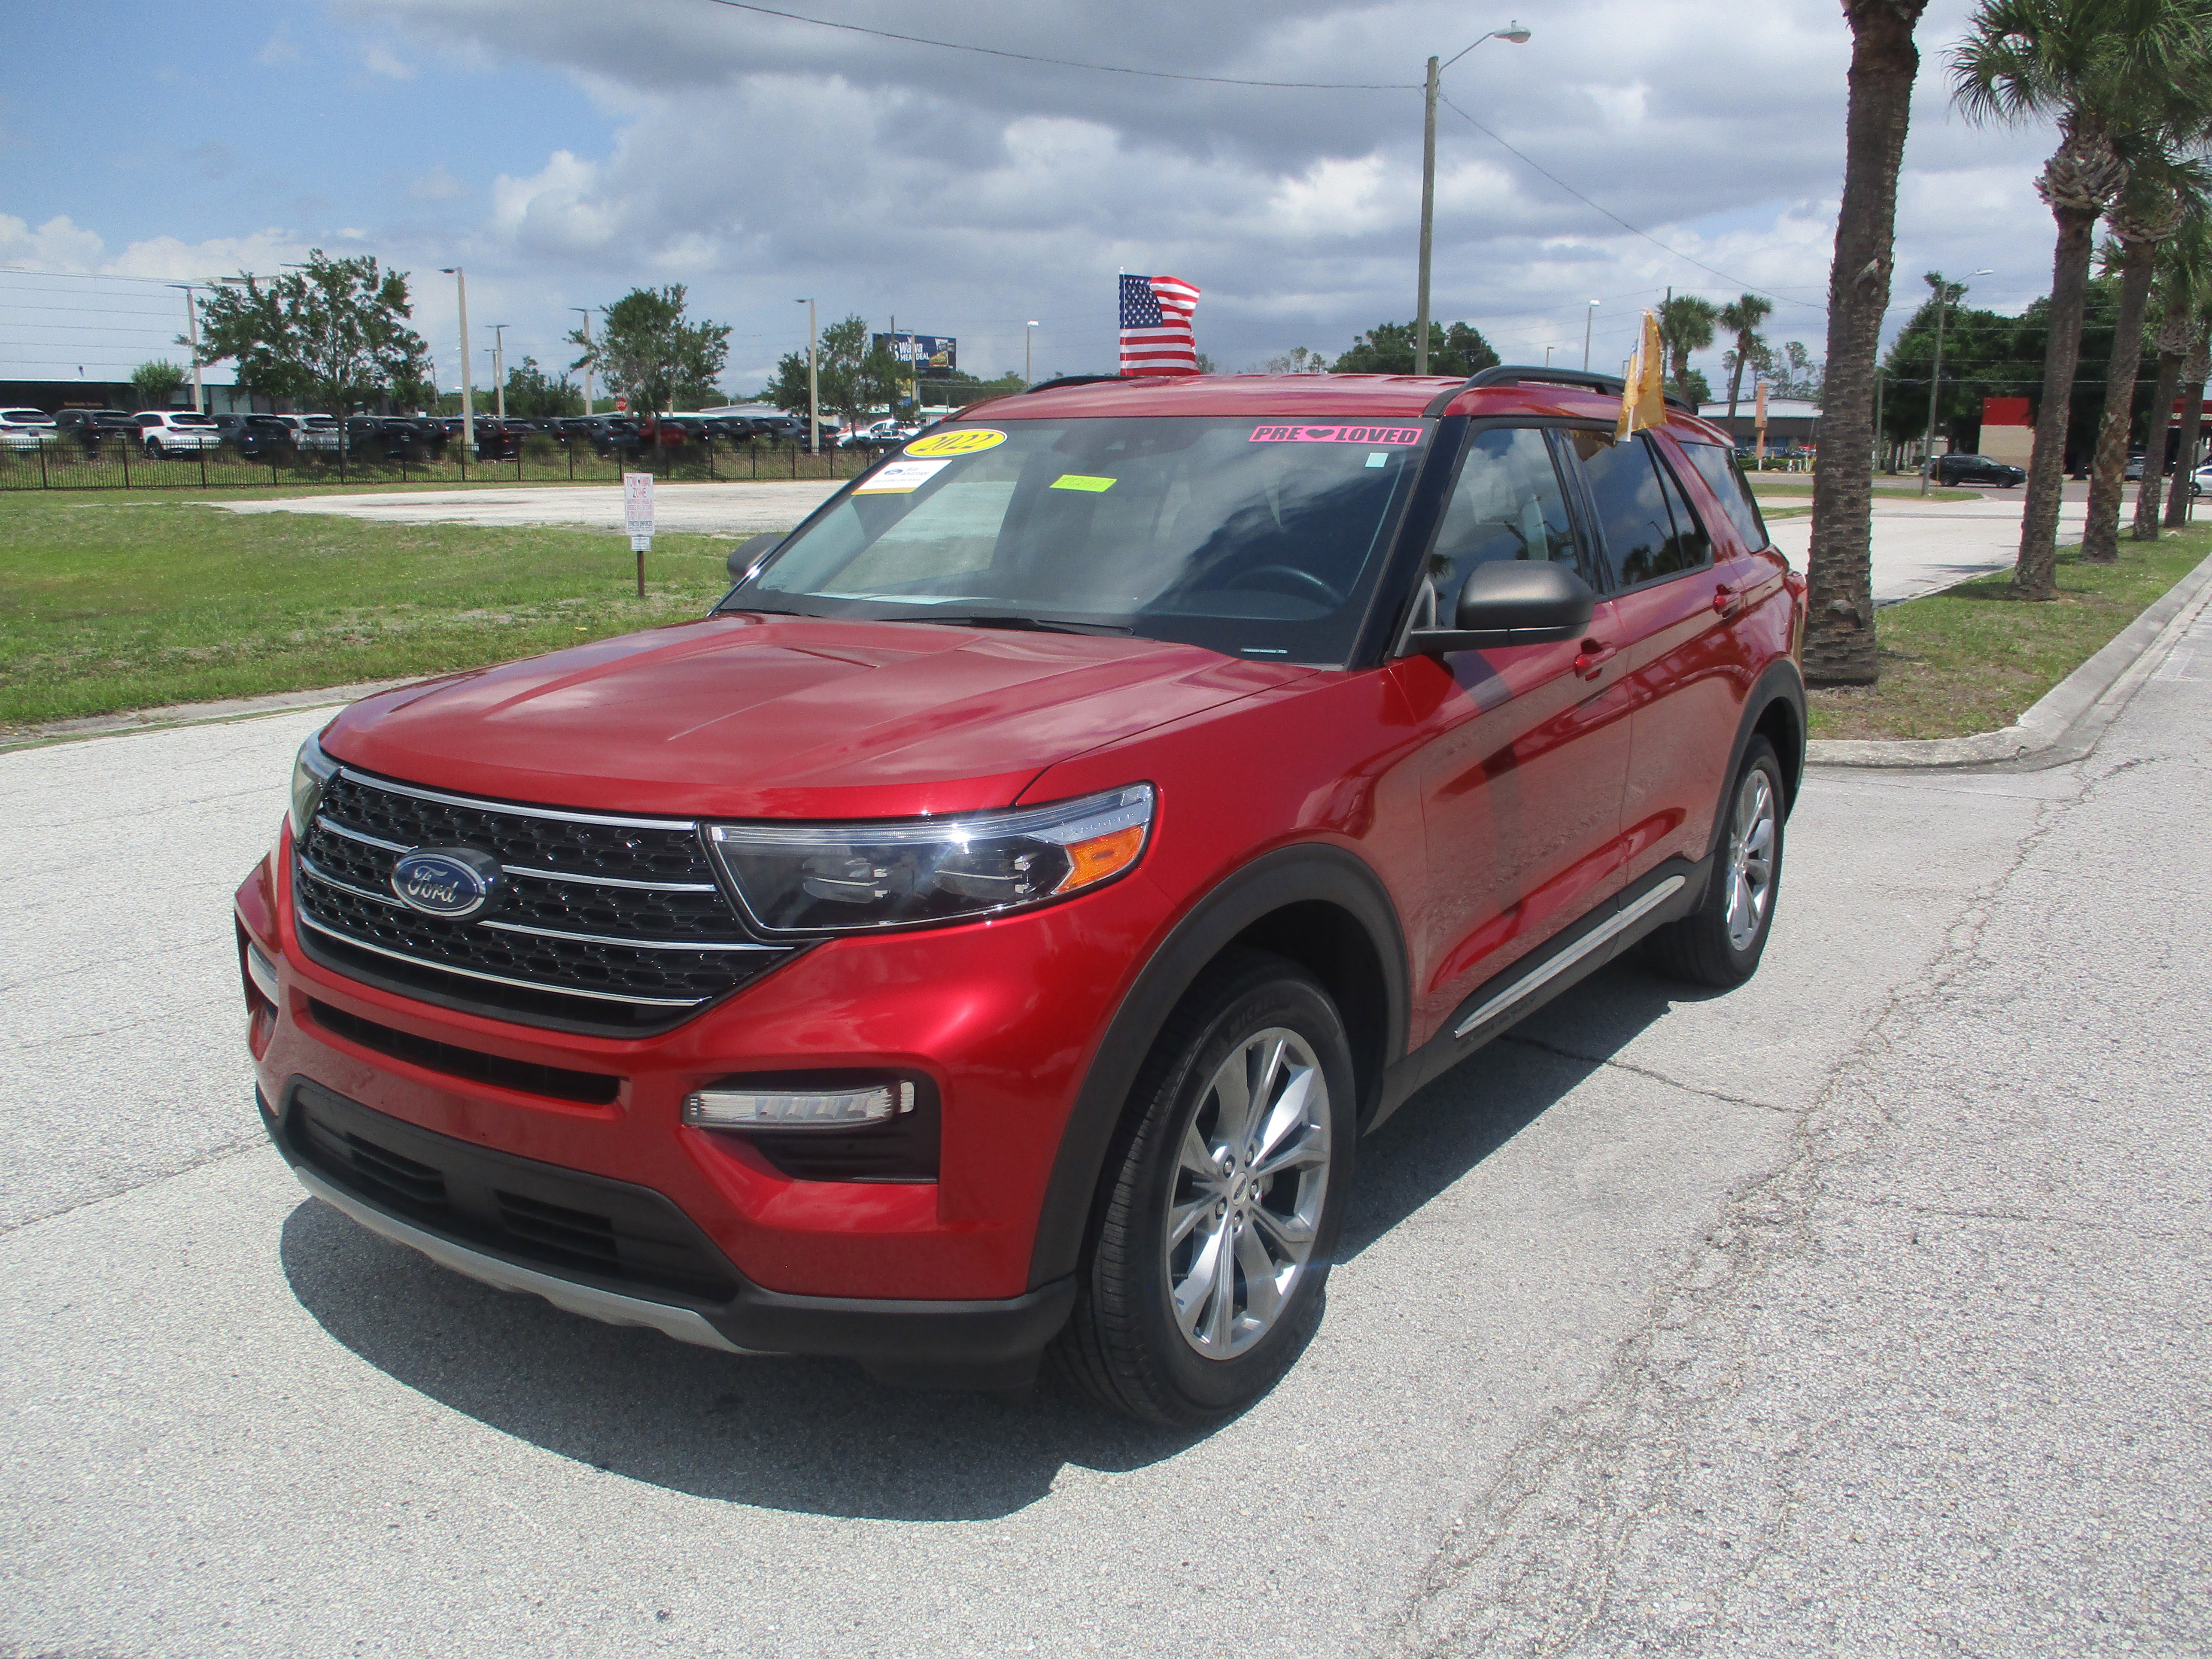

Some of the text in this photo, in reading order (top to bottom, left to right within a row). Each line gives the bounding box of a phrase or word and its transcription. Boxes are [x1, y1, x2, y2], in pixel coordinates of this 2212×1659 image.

[900, 352, 930, 362] MEA DEAL
[1252, 427, 1418, 443] PRE LOVED
[909, 434, 995, 452] 2022
[626, 476, 637, 487] TOW
[632, 487, 647, 498] ZONE
[408, 866, 459, 903] Ford
